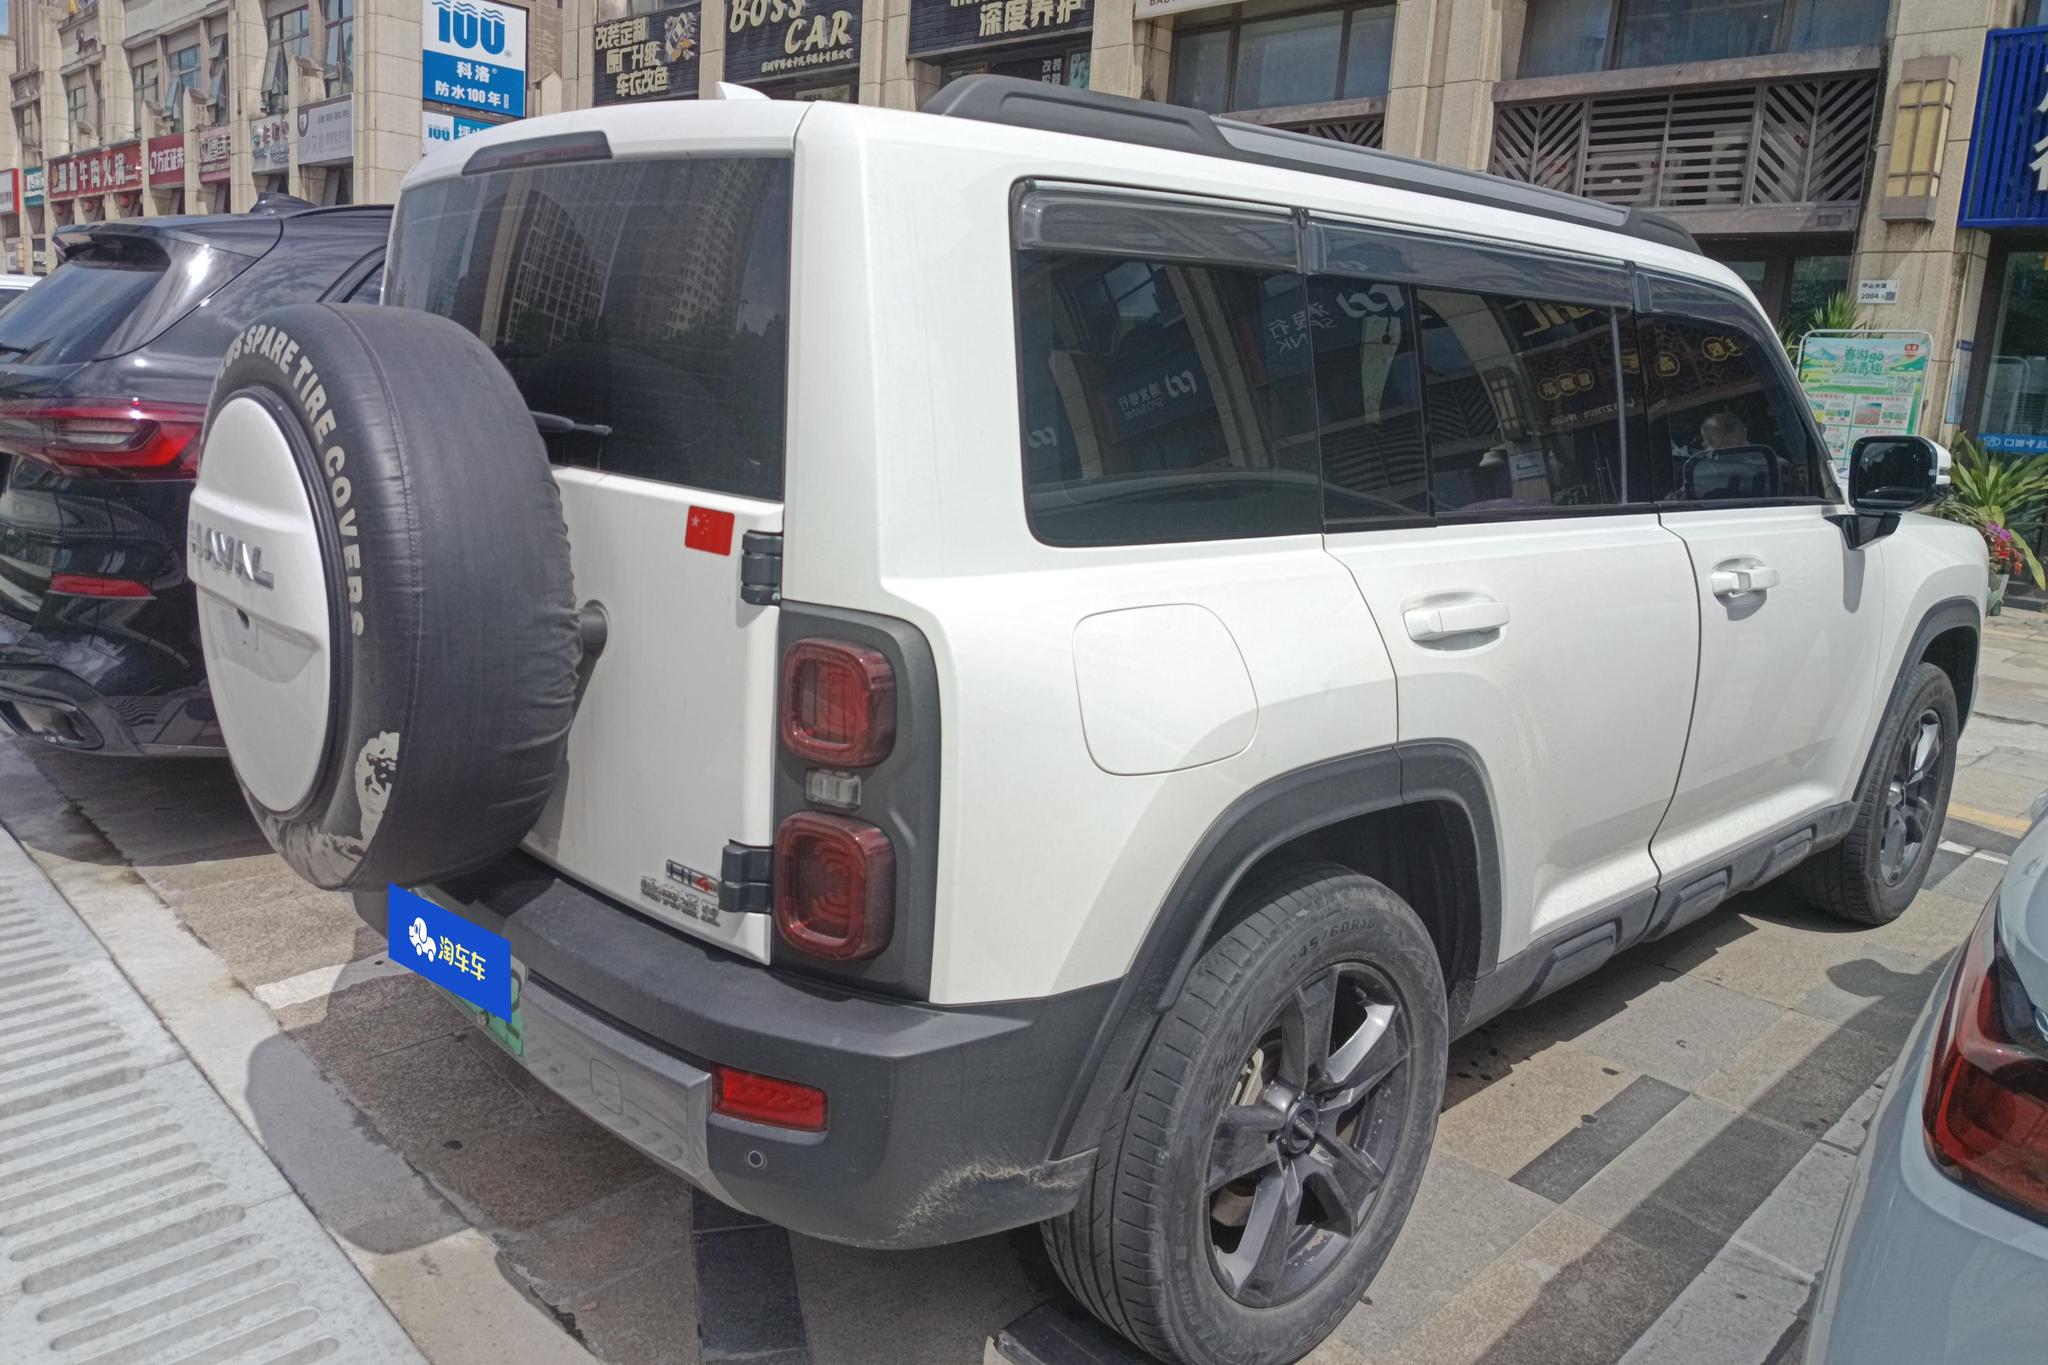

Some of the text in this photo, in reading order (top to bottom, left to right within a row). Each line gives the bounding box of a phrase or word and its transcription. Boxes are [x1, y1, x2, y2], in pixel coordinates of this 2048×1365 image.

[729, 0, 804, 33] BOSS
[784, 10, 852, 54] CAR
[979, 0, 1082, 36] 深度养护
[456, 61, 490, 83] 科洛
[606, 41, 660, 74] 原厂升级
[616, 67, 668, 97] 车衣改色
[244, 324, 365, 637] SPARE TIRE COVERS
[189, 519, 274, 589] HAVAL
